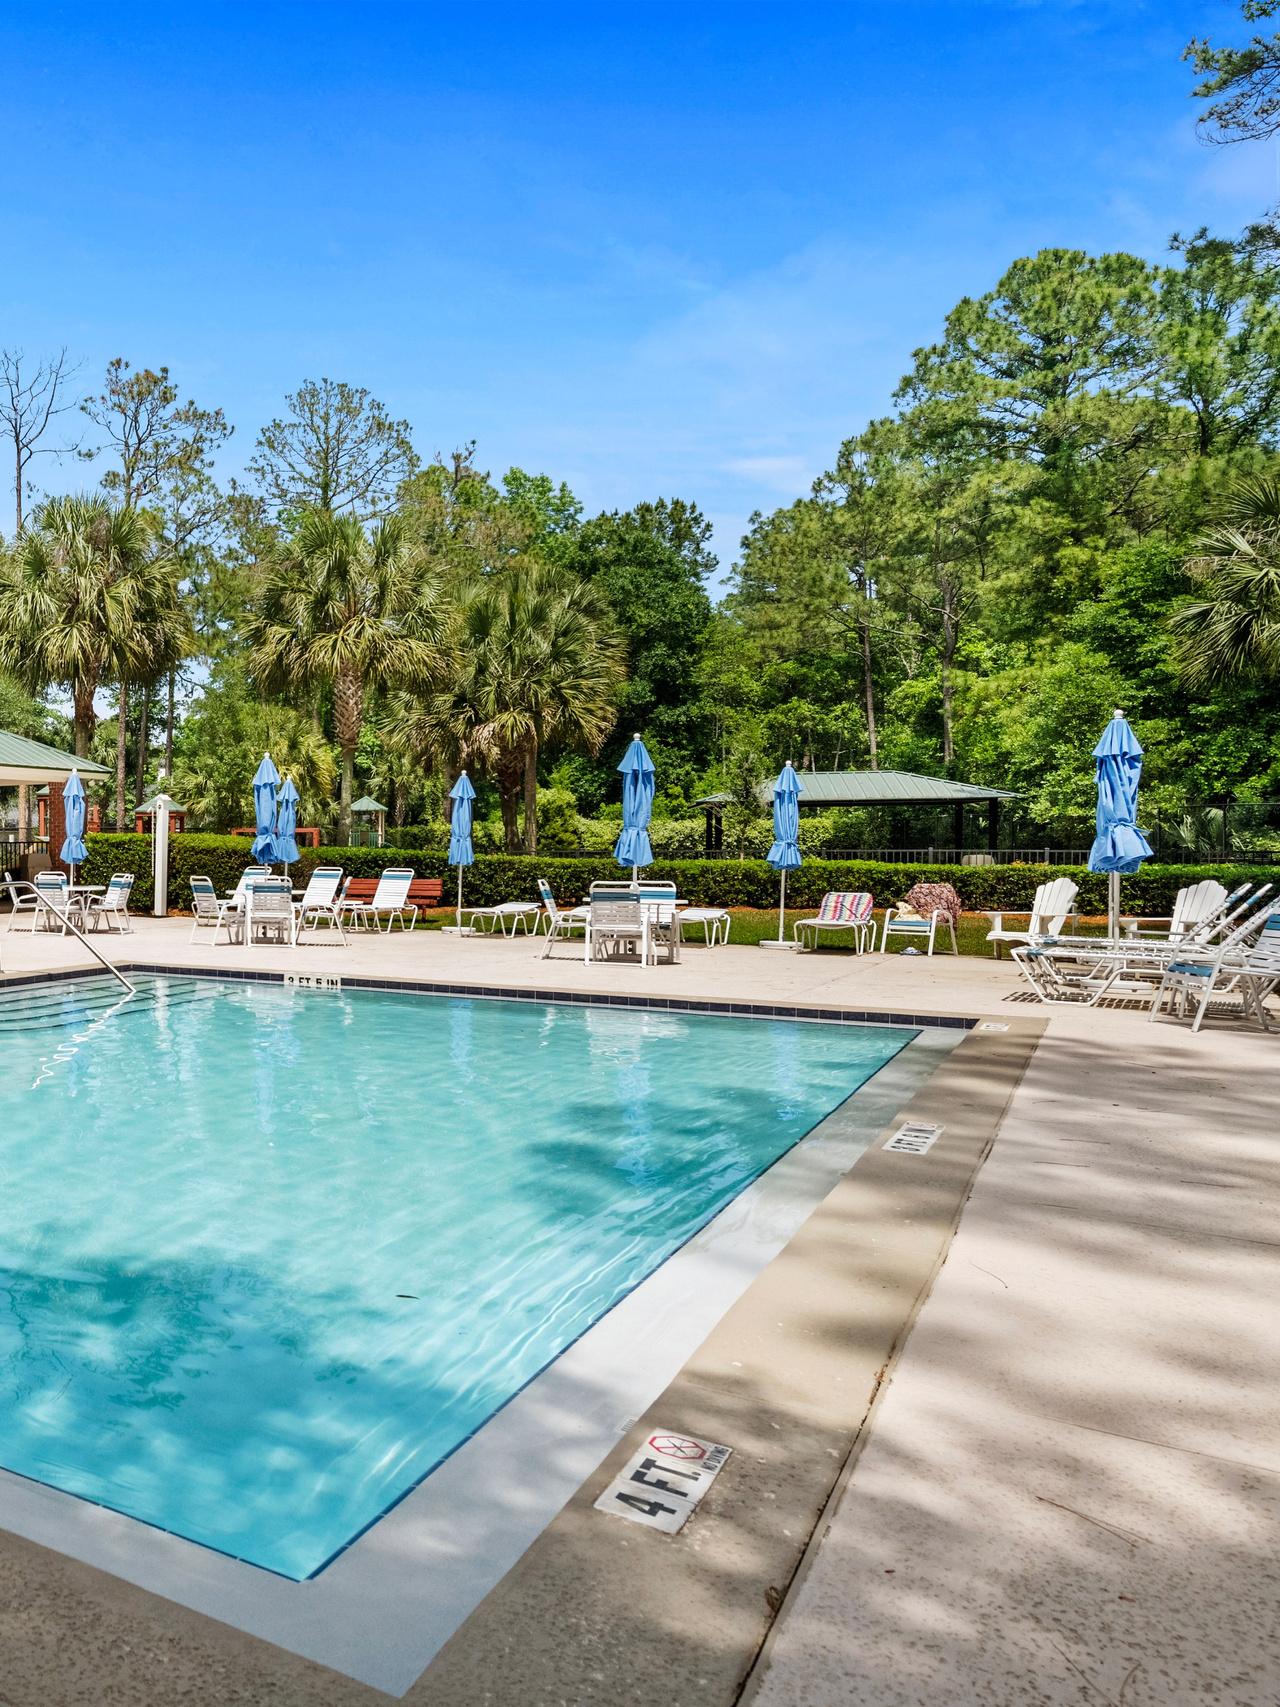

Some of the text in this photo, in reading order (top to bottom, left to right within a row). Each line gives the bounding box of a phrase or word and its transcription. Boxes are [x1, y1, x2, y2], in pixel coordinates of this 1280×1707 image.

[700, 1445, 730, 1473] NO DIVING
[615, 1457, 702, 1517] 4 FT.
